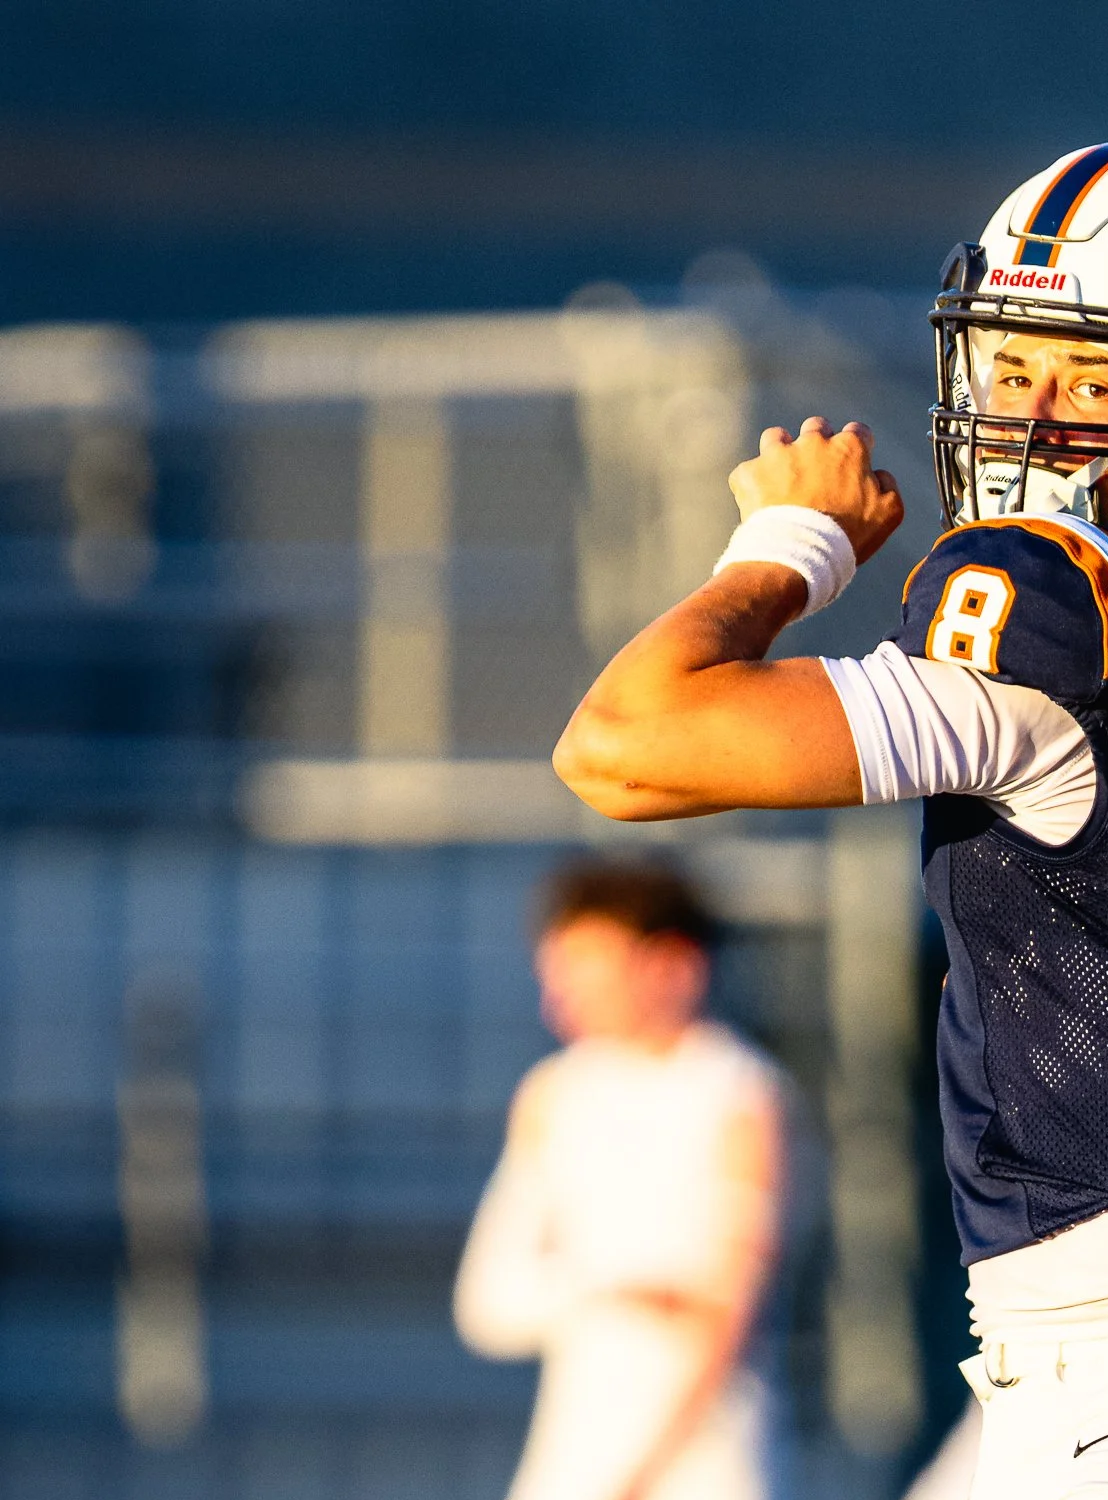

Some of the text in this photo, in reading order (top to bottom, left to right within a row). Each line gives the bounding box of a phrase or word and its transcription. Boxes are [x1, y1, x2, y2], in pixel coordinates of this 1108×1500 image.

[989, 269, 1067, 291] Riddell
[952, 373, 972, 412] Ridd
[925, 563, 1016, 675] 8
